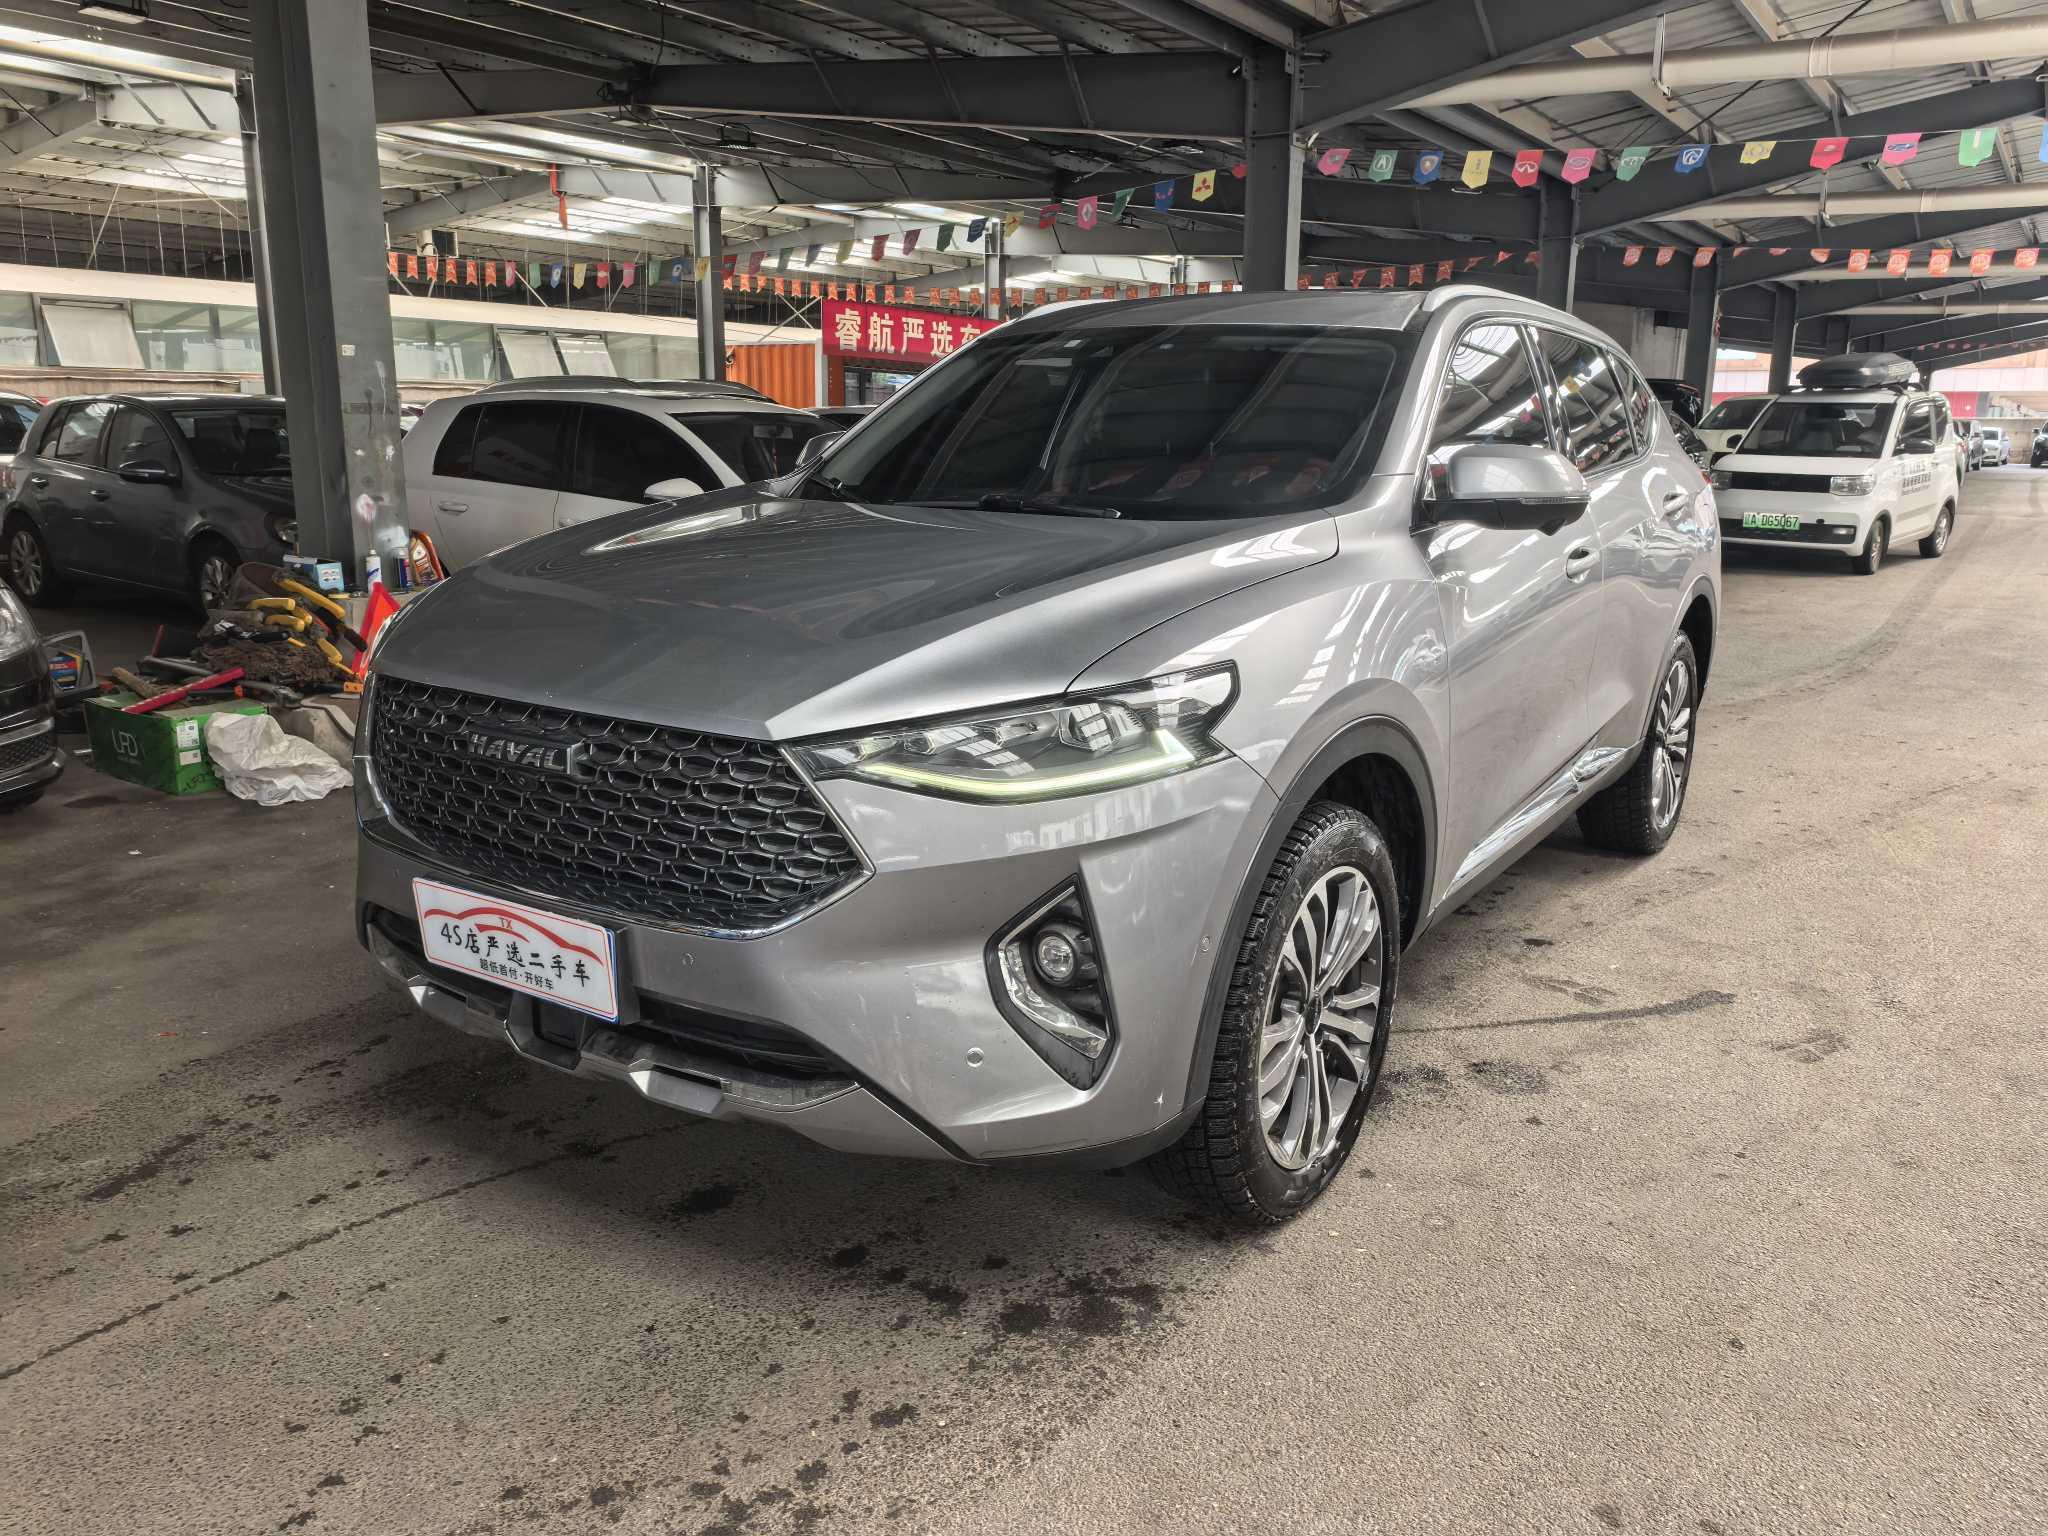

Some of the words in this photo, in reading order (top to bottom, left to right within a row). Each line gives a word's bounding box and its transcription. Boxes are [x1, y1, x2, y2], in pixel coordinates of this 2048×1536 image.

[1761, 514, 1799, 528] DG5067
[469, 733, 565, 770] HAVAL
[440, 922, 591, 988] 4S店严选二手车
